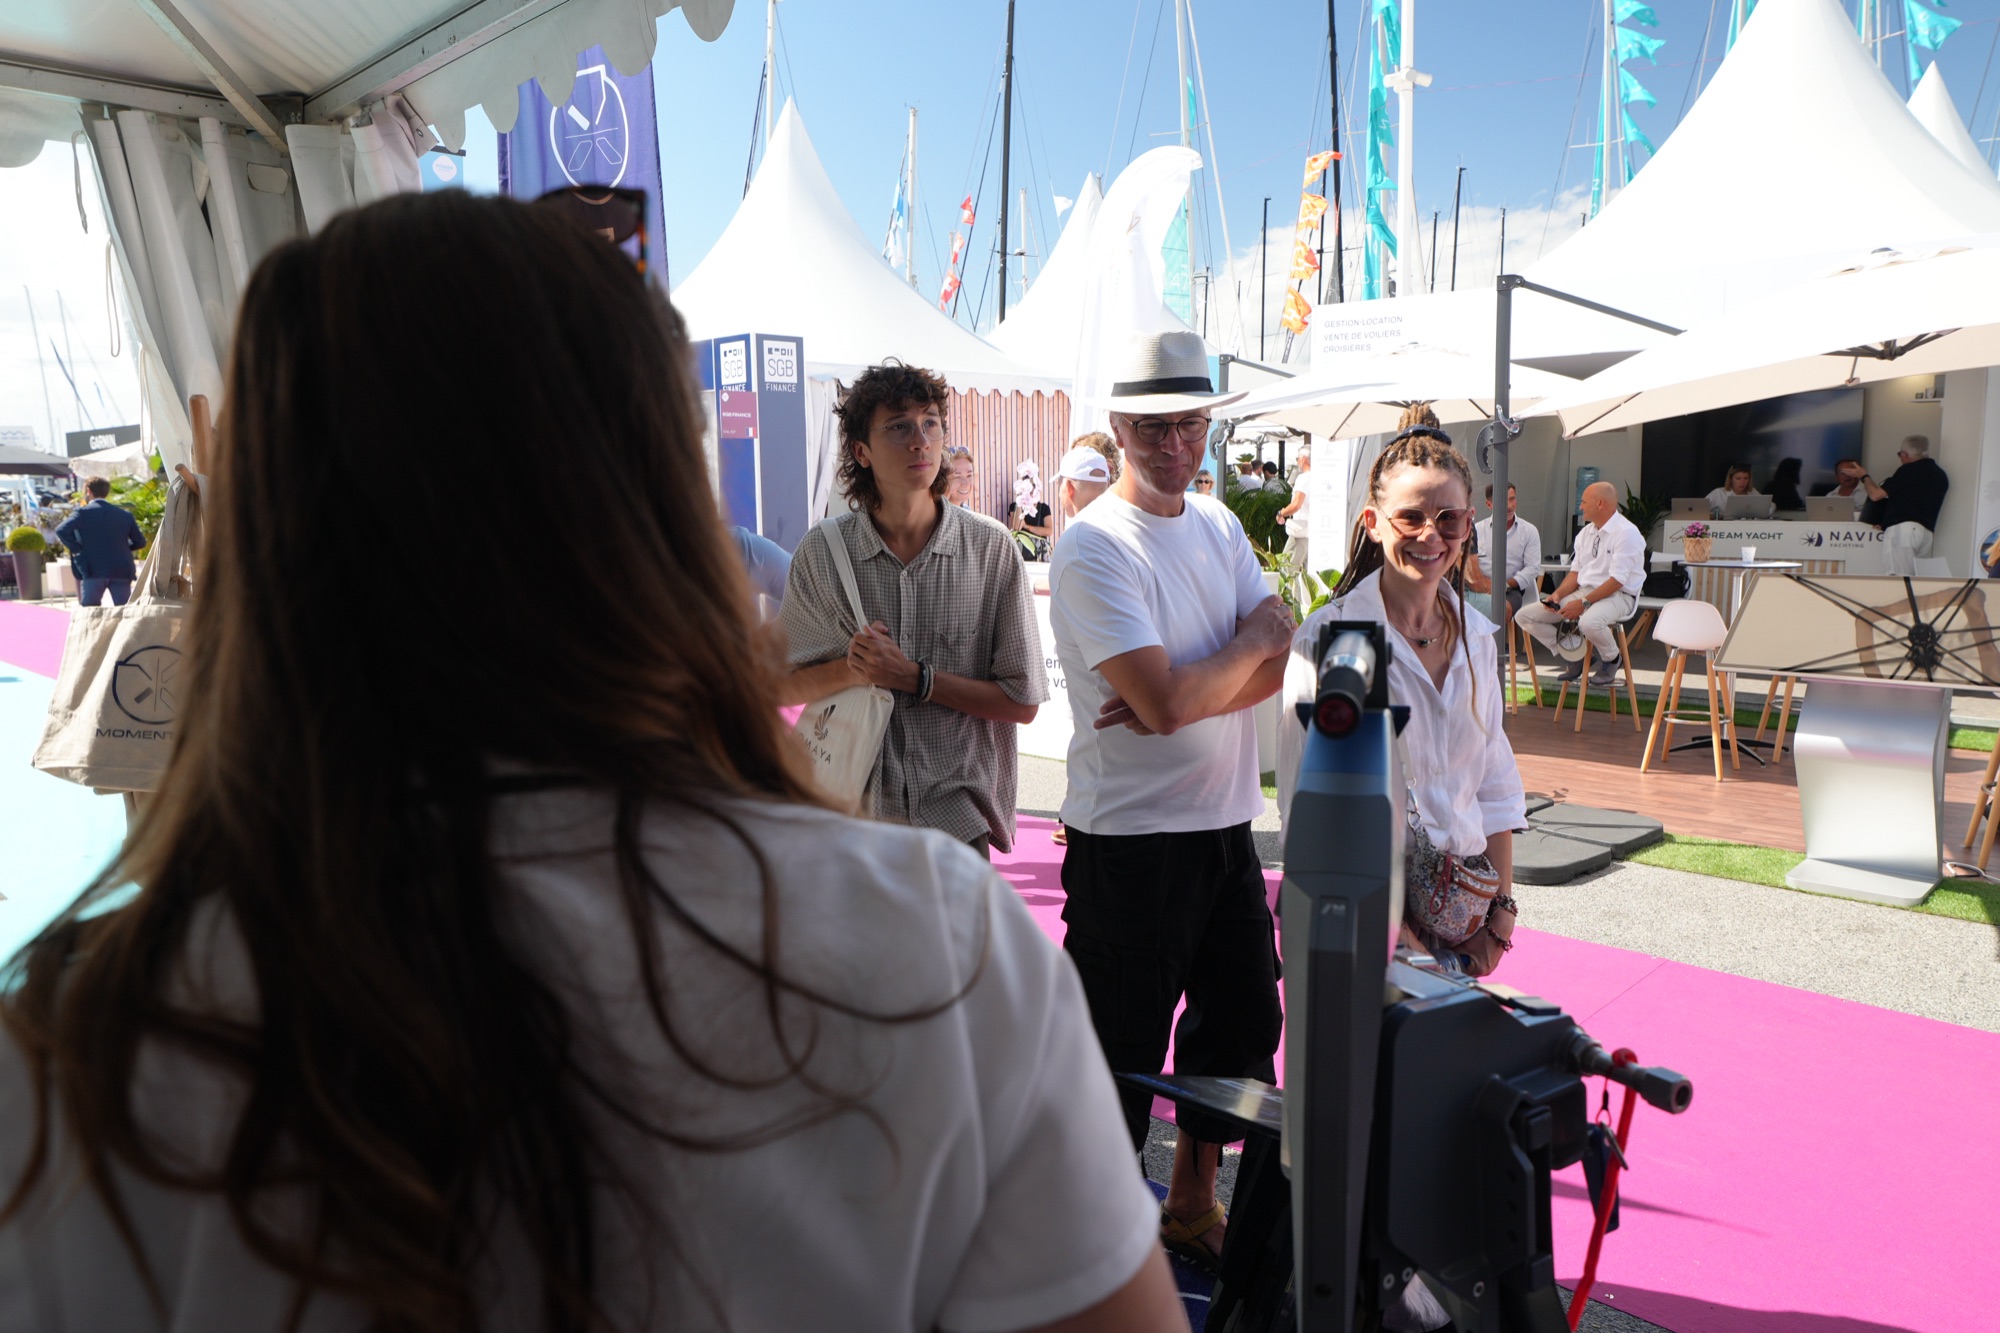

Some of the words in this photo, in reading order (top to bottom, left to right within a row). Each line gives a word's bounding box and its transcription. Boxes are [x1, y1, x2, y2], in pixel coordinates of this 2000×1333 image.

[1324, 333, 1349, 341] VENTE
[1351, 332, 1362, 340] DE
[1364, 329, 1401, 339] VOILIERS
[1323, 343, 1371, 353] CROISIÈRES
[724, 360, 743, 378] SGB
[768, 359, 794, 377] SGB
[723, 384, 746, 392] FINANCE
[766, 383, 797, 392] FINANCE
[90, 434, 117, 450] GARMIN
[1711, 532, 1743, 540] REAM
[1746, 532, 1783, 540] YACHT
